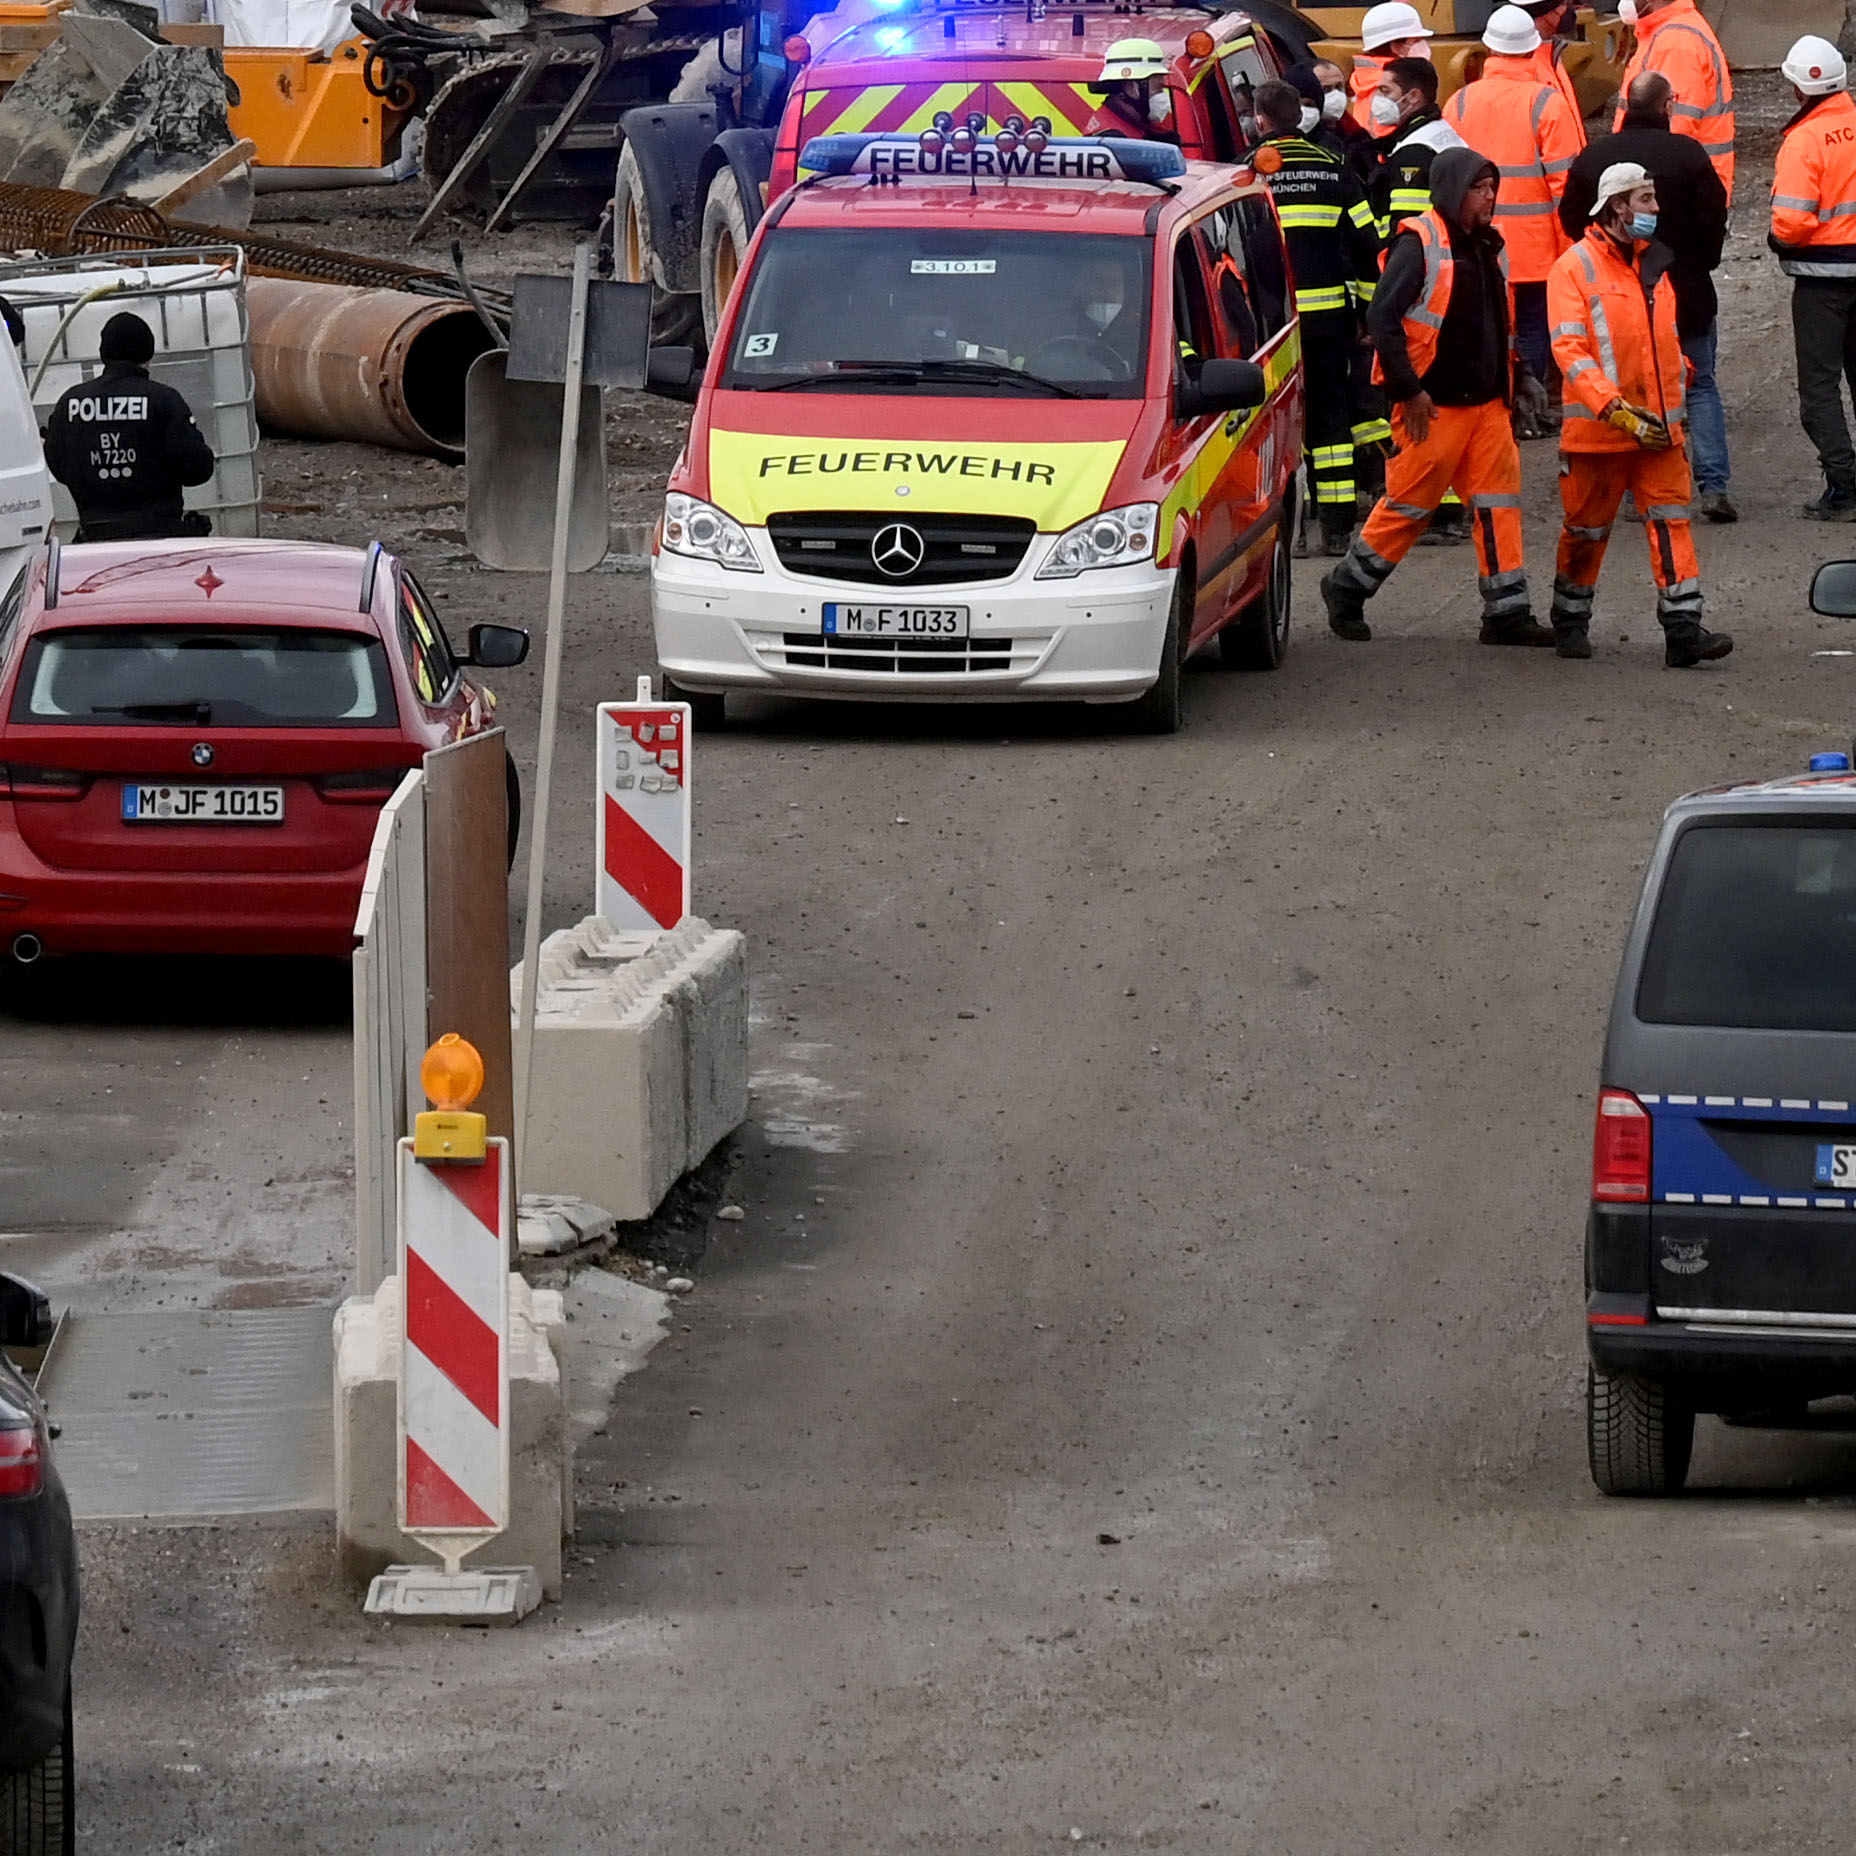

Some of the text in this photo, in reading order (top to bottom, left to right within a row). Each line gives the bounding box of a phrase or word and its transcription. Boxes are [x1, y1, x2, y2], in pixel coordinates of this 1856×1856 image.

[1825, 127, 1855, 146] ATC
[870, 147, 1112, 178] FEUERWEHR
[754, 336, 770, 353] 3
[68, 396, 149, 423] POLIZEI
[100, 432, 121, 450] BY
[90, 448, 137, 466] M 7220
[758, 452, 1057, 487] FEUERWEHR
[846, 609, 862, 635] M
[877, 609, 892, 635] F
[898, 608, 959, 635] 1033
[139, 785, 156, 815] M
[175, 785, 209, 815] JF
[214, 785, 280, 815] 1015
